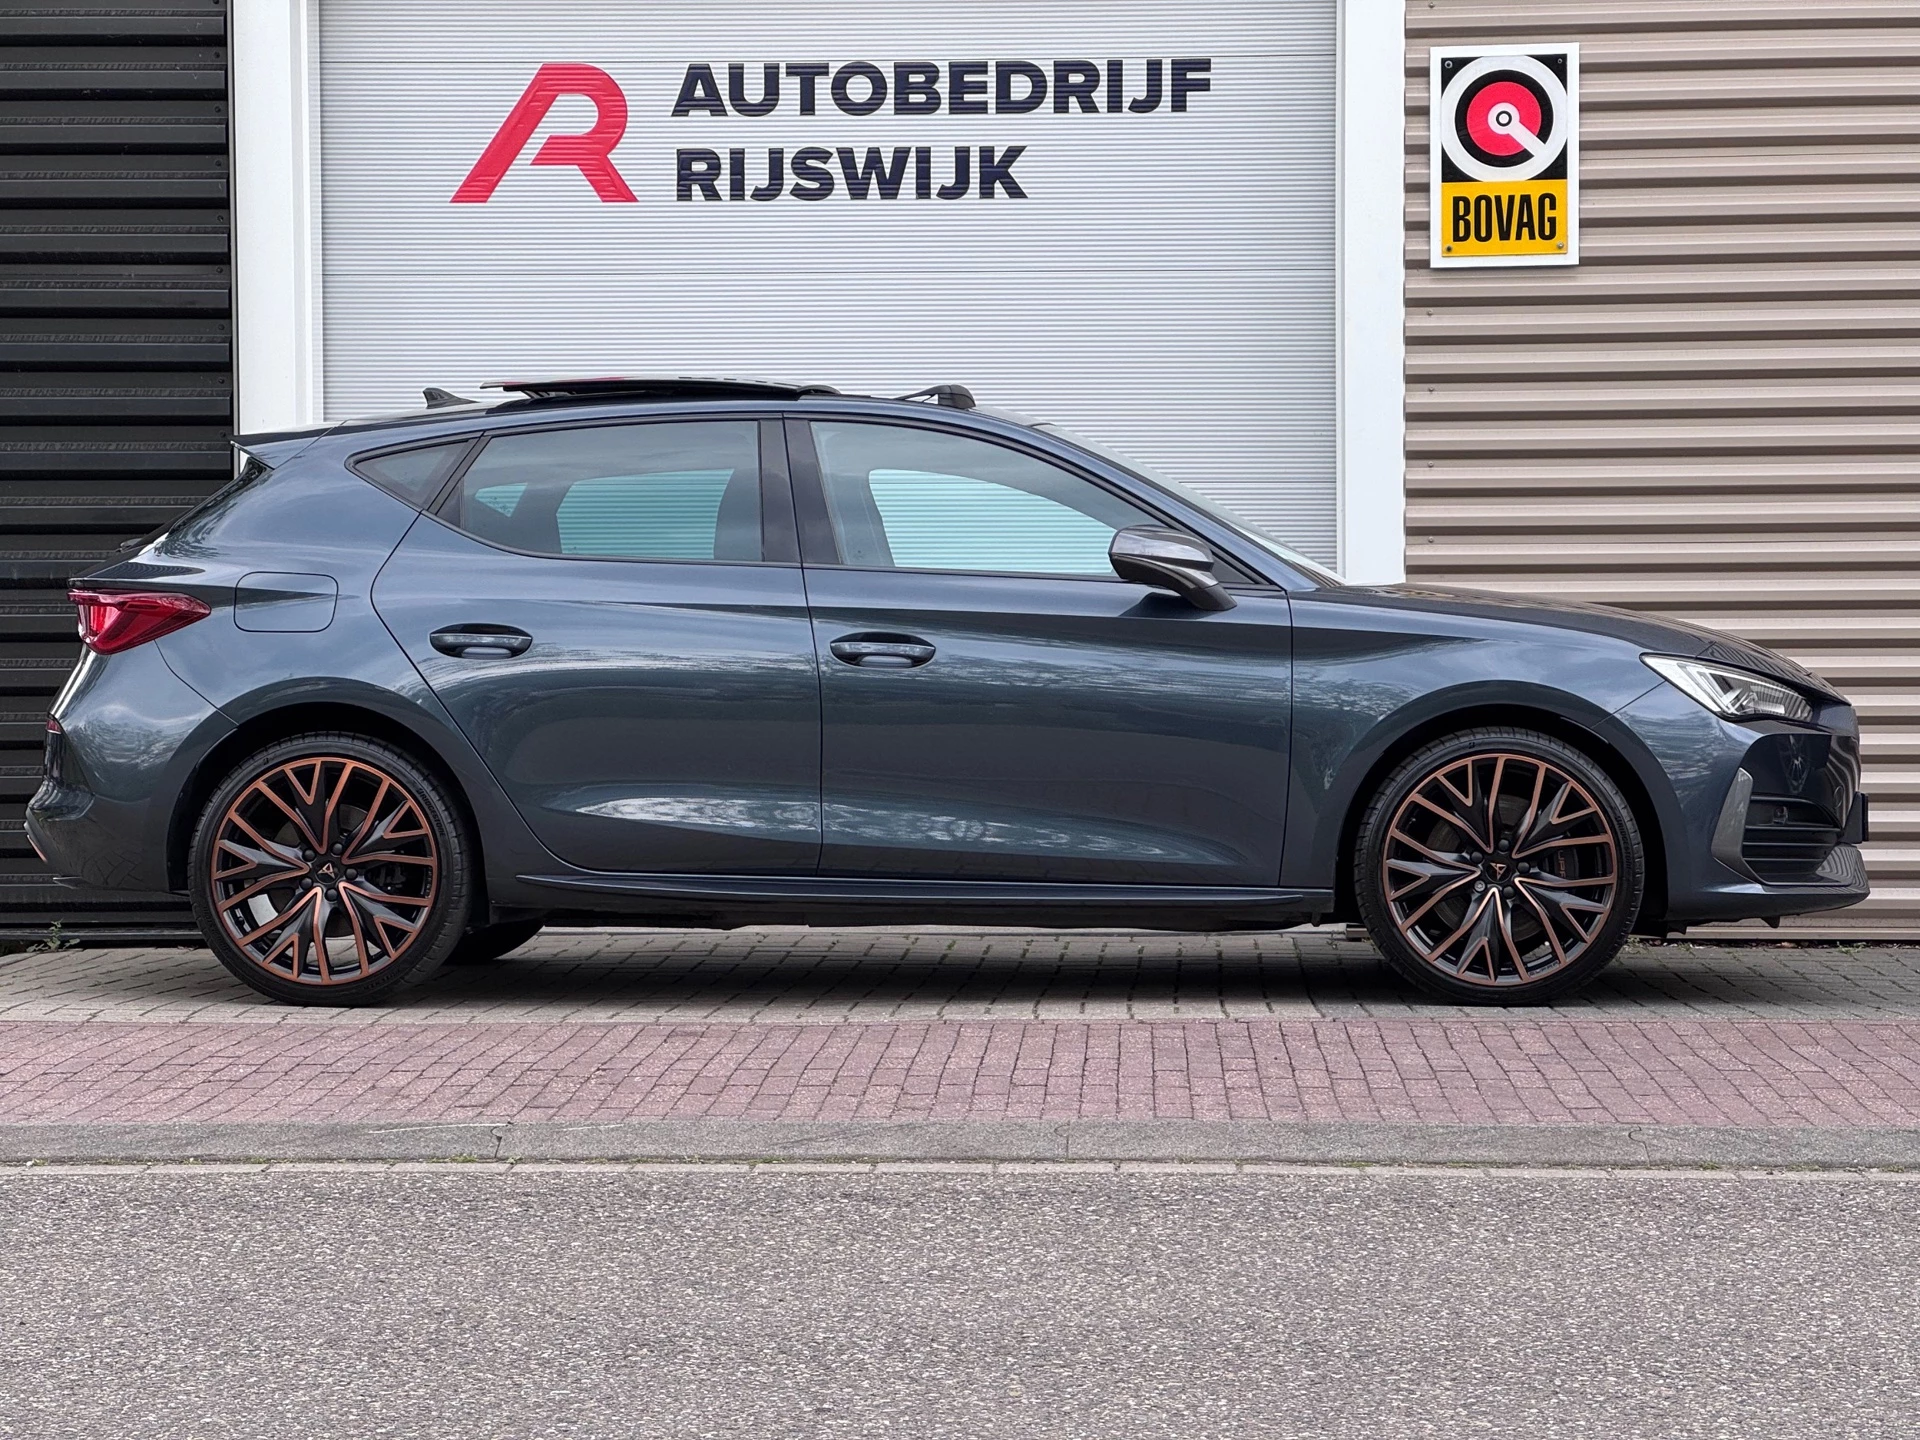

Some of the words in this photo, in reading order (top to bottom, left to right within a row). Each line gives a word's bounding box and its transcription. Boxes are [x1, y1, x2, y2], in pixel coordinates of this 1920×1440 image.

[672, 58, 1211, 117] AUTOBEDRIJF
[677, 146, 1027, 201] RIJSWIJK
[1453, 193, 1556, 242] BOVAG
